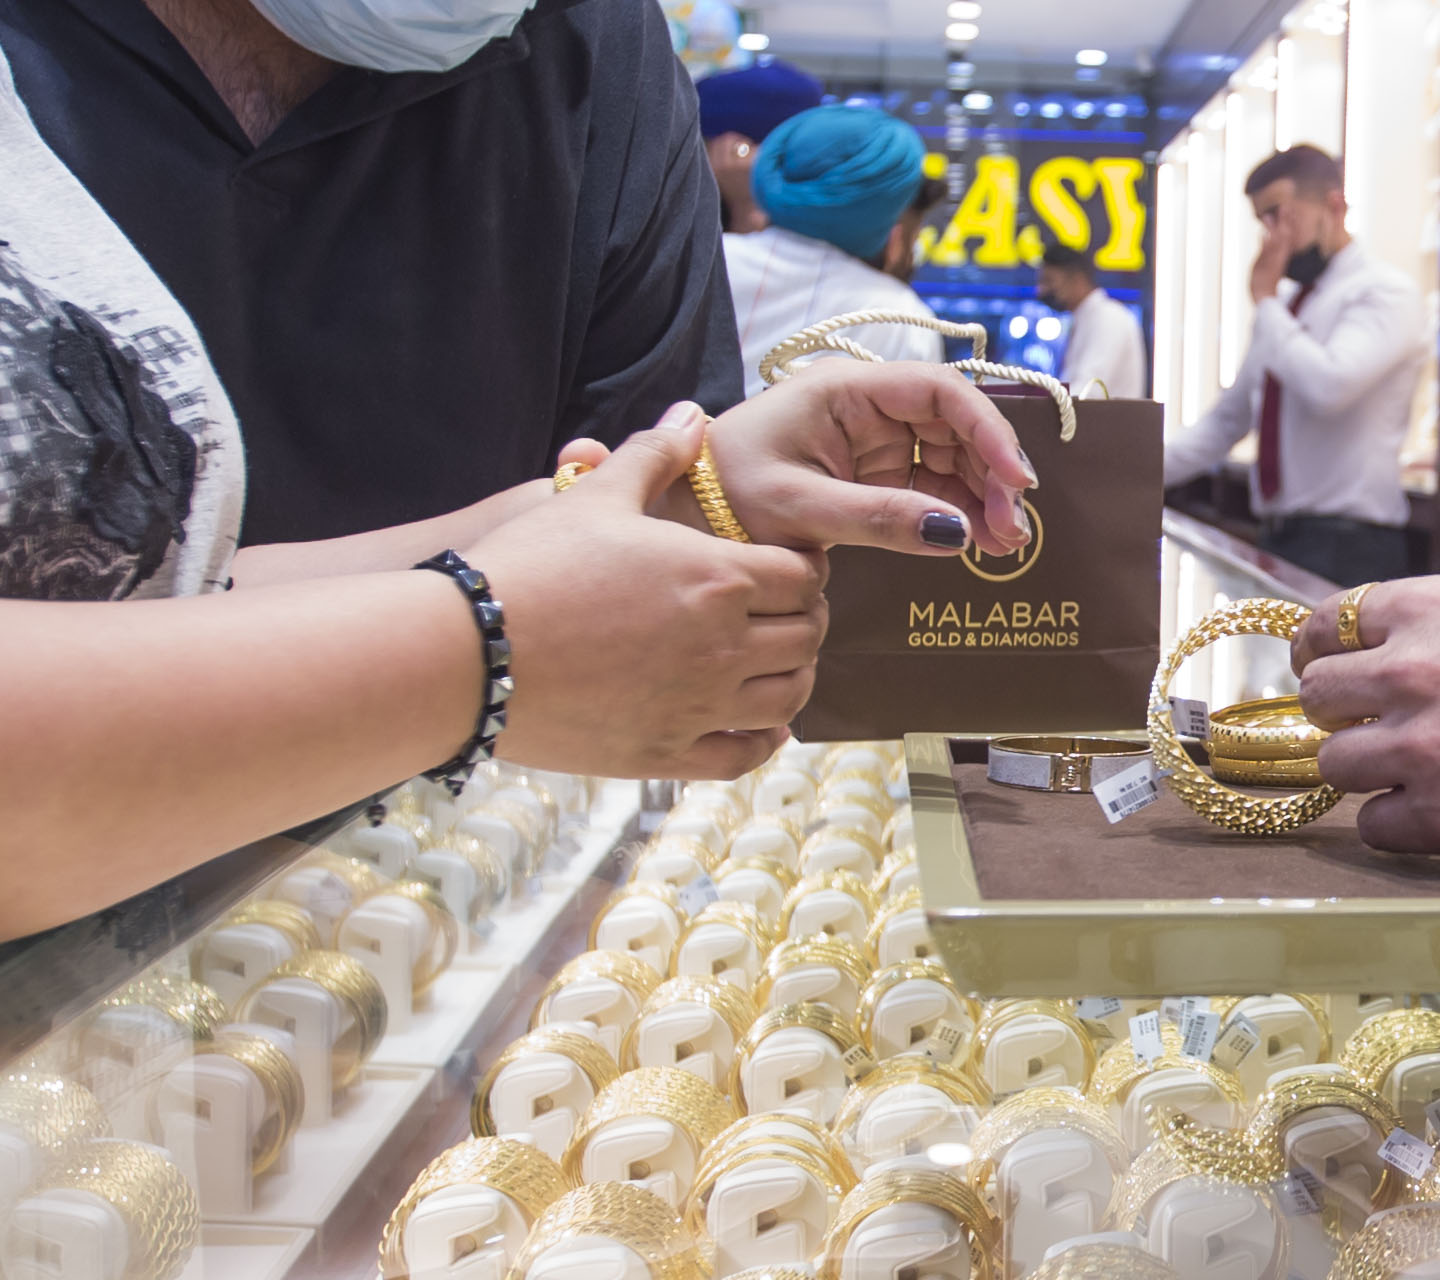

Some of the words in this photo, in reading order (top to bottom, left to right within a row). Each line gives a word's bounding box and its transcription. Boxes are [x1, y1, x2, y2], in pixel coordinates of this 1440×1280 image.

[909, 601, 1080, 628] MALABAR
[908, 631, 961, 647] GOLD
[964, 631, 977, 647] &
[980, 631, 1079, 647] DIAMONDS
